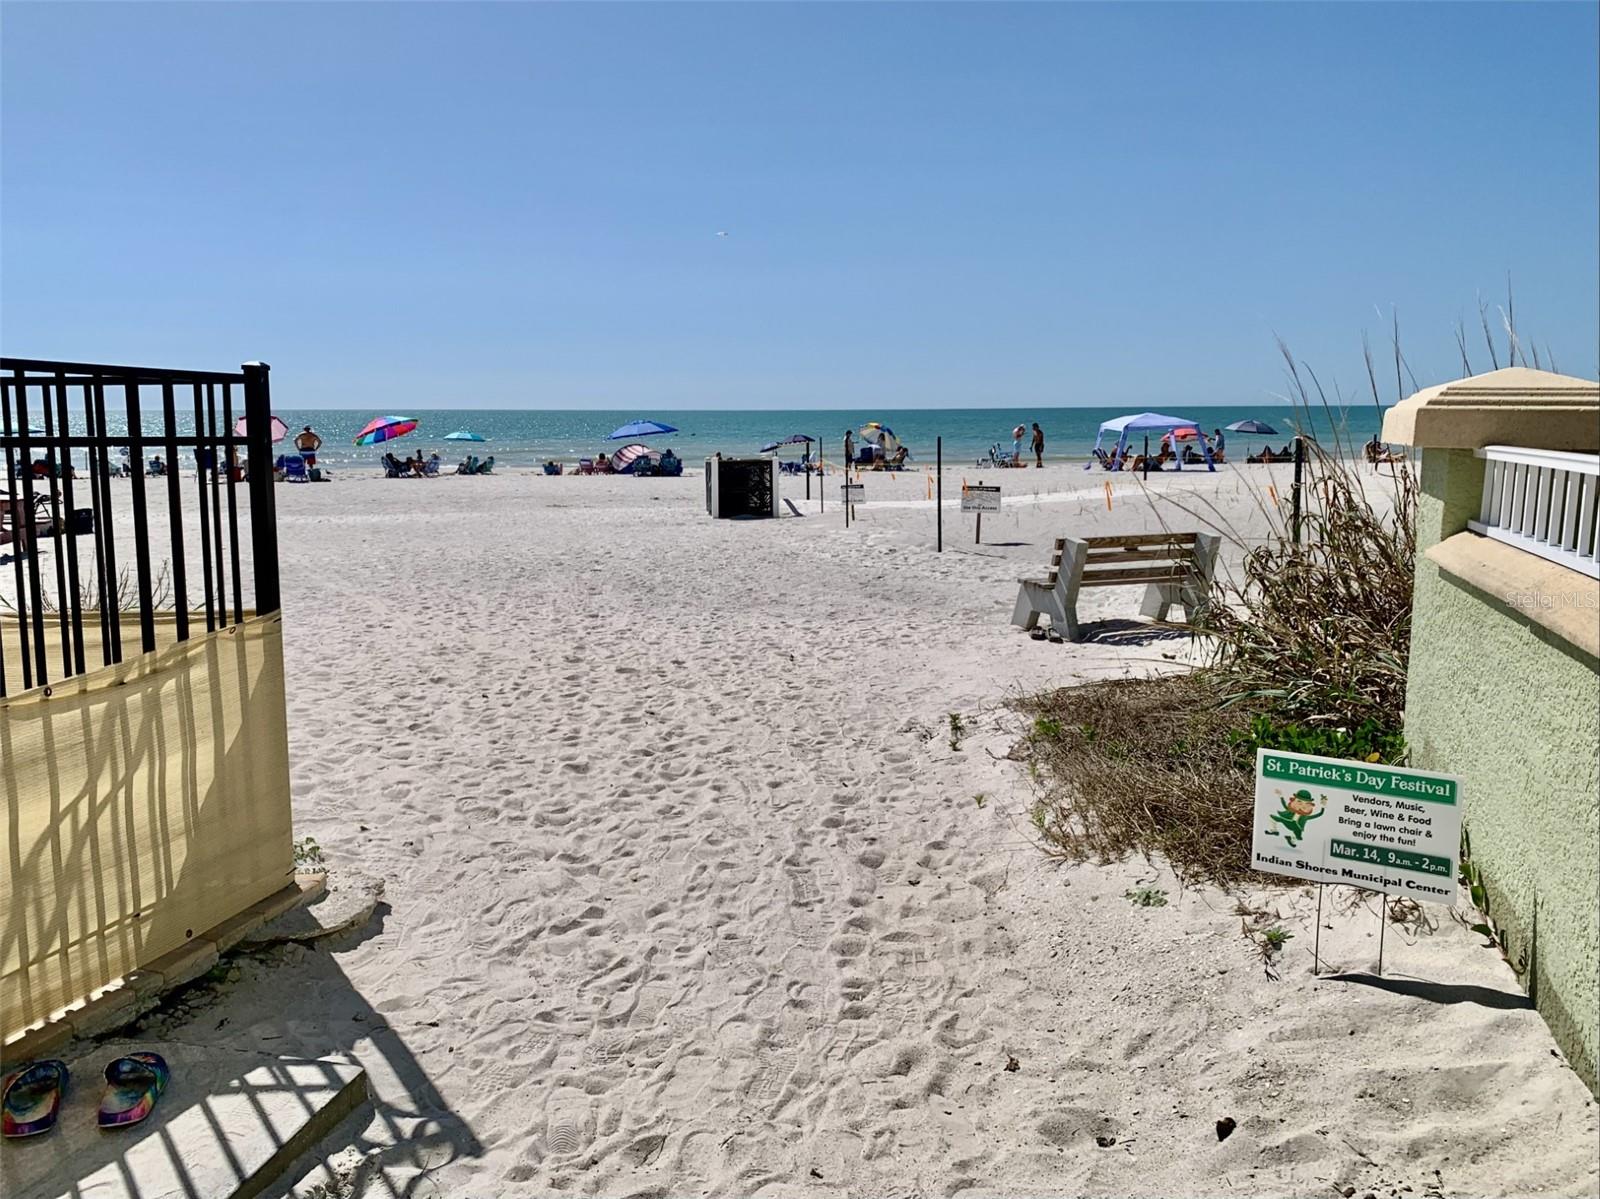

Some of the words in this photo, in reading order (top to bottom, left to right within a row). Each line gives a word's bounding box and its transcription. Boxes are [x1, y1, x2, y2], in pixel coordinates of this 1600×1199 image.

[1266, 758, 1285, 772] St.
[1289, 761, 1352, 782] Patrick's
[1356, 771, 1386, 789] Day
[1391, 775, 1450, 796] Festival
[1352, 794, 1393, 809] Vendors,
[1395, 801, 1425, 813] Music,
[1344, 805, 1367, 817] Beer,
[1370, 809, 1395, 820] Wine
[1397, 813, 1405, 822] &
[1408, 815, 1432, 826] Food
[1338, 816, 1362, 829] Bring
[1373, 822, 1396, 833] lawn
[1399, 826, 1422, 838] chair
[1425, 830, 1433, 839] &
[1352, 830, 1377, 842] enjoy
[1379, 834, 1395, 843] the
[1398, 836, 1416, 847] fun!
[1332, 843, 1360, 858] Mar.
[1363, 848, 1380, 862] 14,
[1256, 853, 1292, 868] Indian
[1295, 860, 1338, 876] Shores
[1341, 868, 1402, 887] Municipal
[1405, 880, 1451, 896] Center
